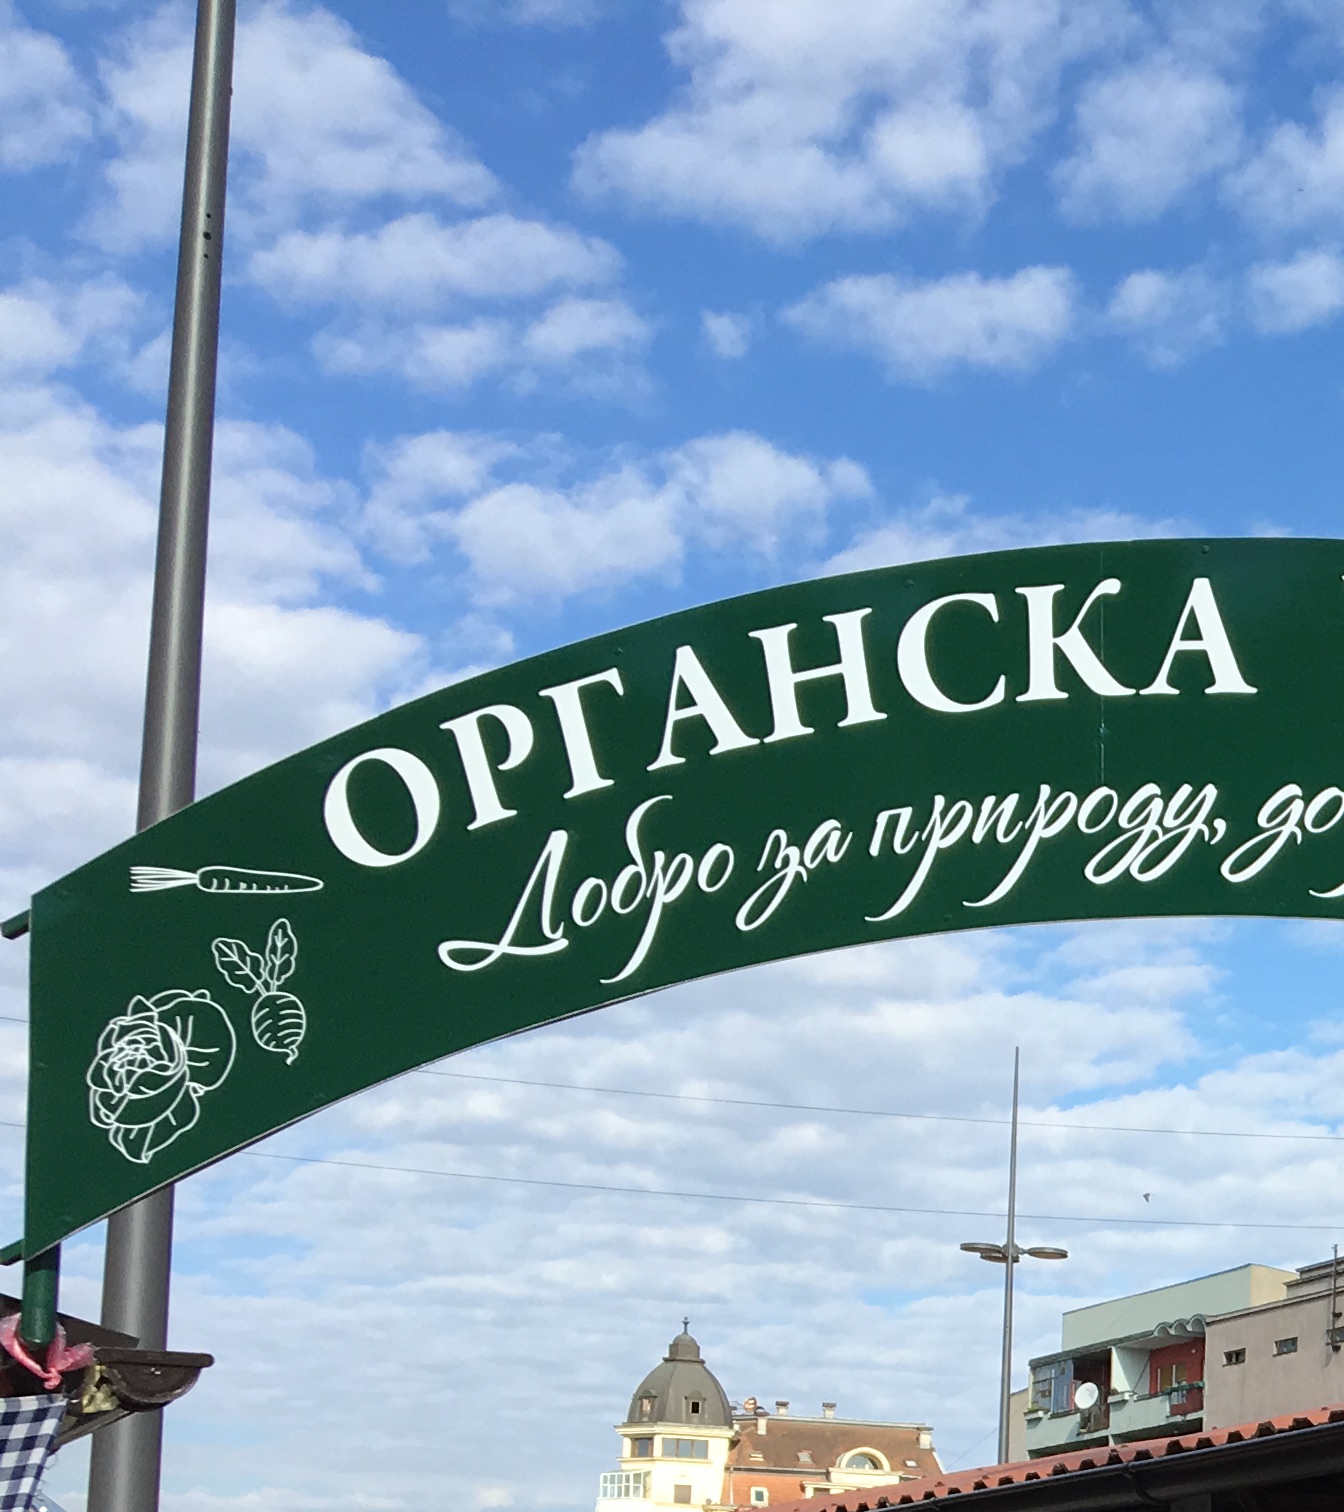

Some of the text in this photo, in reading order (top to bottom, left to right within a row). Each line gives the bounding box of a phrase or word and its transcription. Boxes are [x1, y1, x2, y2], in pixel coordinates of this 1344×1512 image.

[324, 578, 1258, 868] ОРГАНСКА
[437, 795, 735, 984] Добро
[736, 819, 853, 932] за
